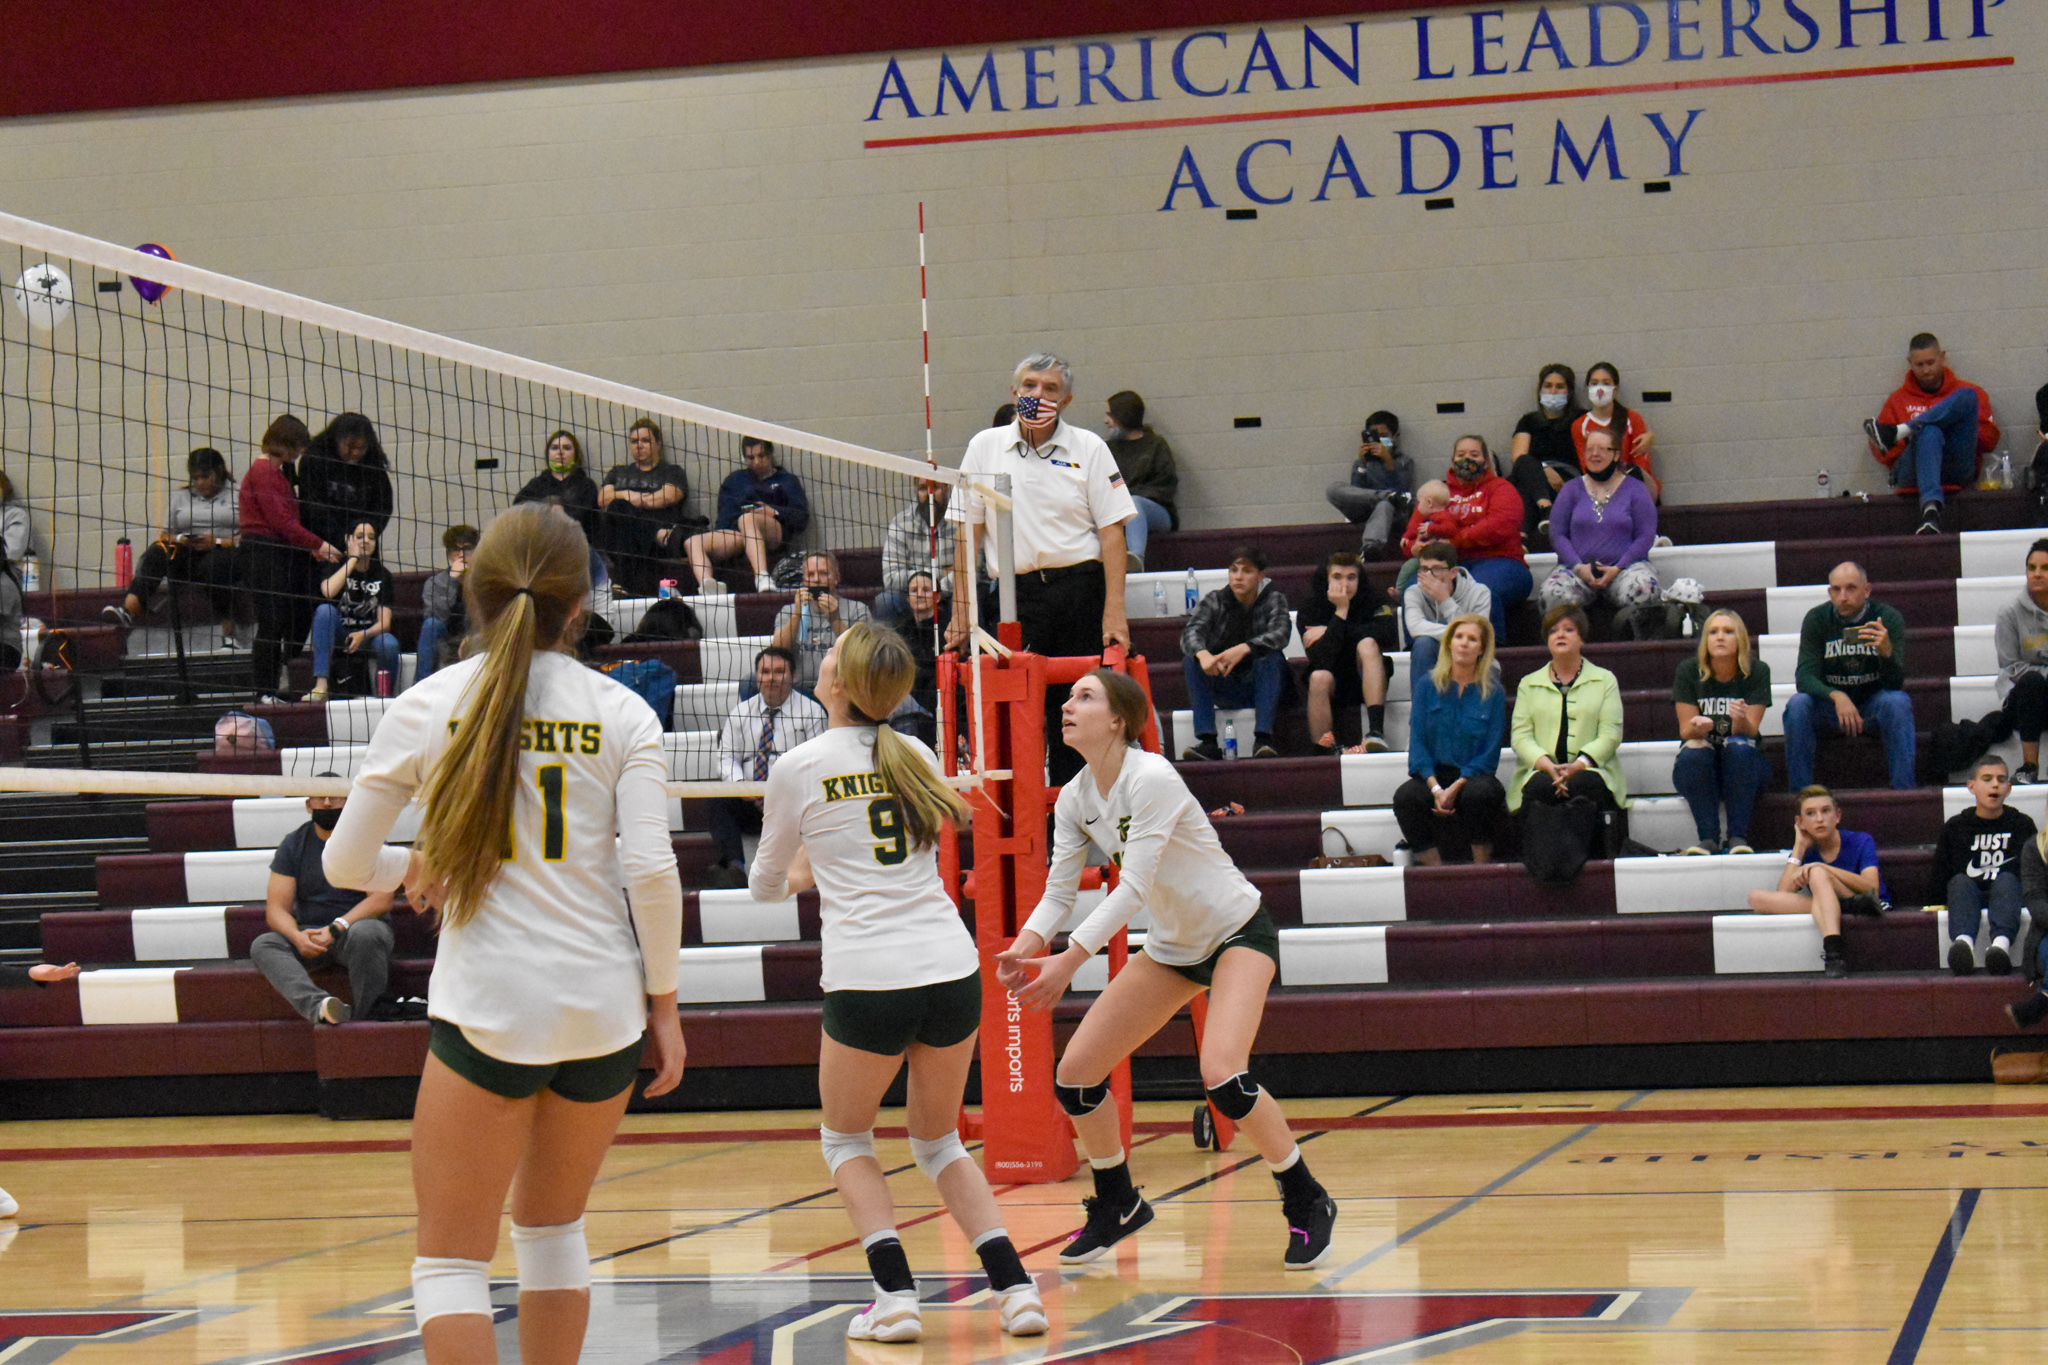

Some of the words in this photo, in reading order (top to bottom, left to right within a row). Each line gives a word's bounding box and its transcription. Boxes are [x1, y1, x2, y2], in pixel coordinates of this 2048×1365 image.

[863, 21, 1365, 122] AMERICAN
[1157, 109, 1706, 212] ACADEMY
[822, 772, 886, 803] KNIG
[867, 796, 909, 866] 9
[1970, 832, 2012, 851] JUST
[1980, 849, 2004, 868] DO
[1982, 867, 2001, 881] IT
[1006, 989, 1022, 1023] orts
[1005, 1025, 1025, 1093] imports
